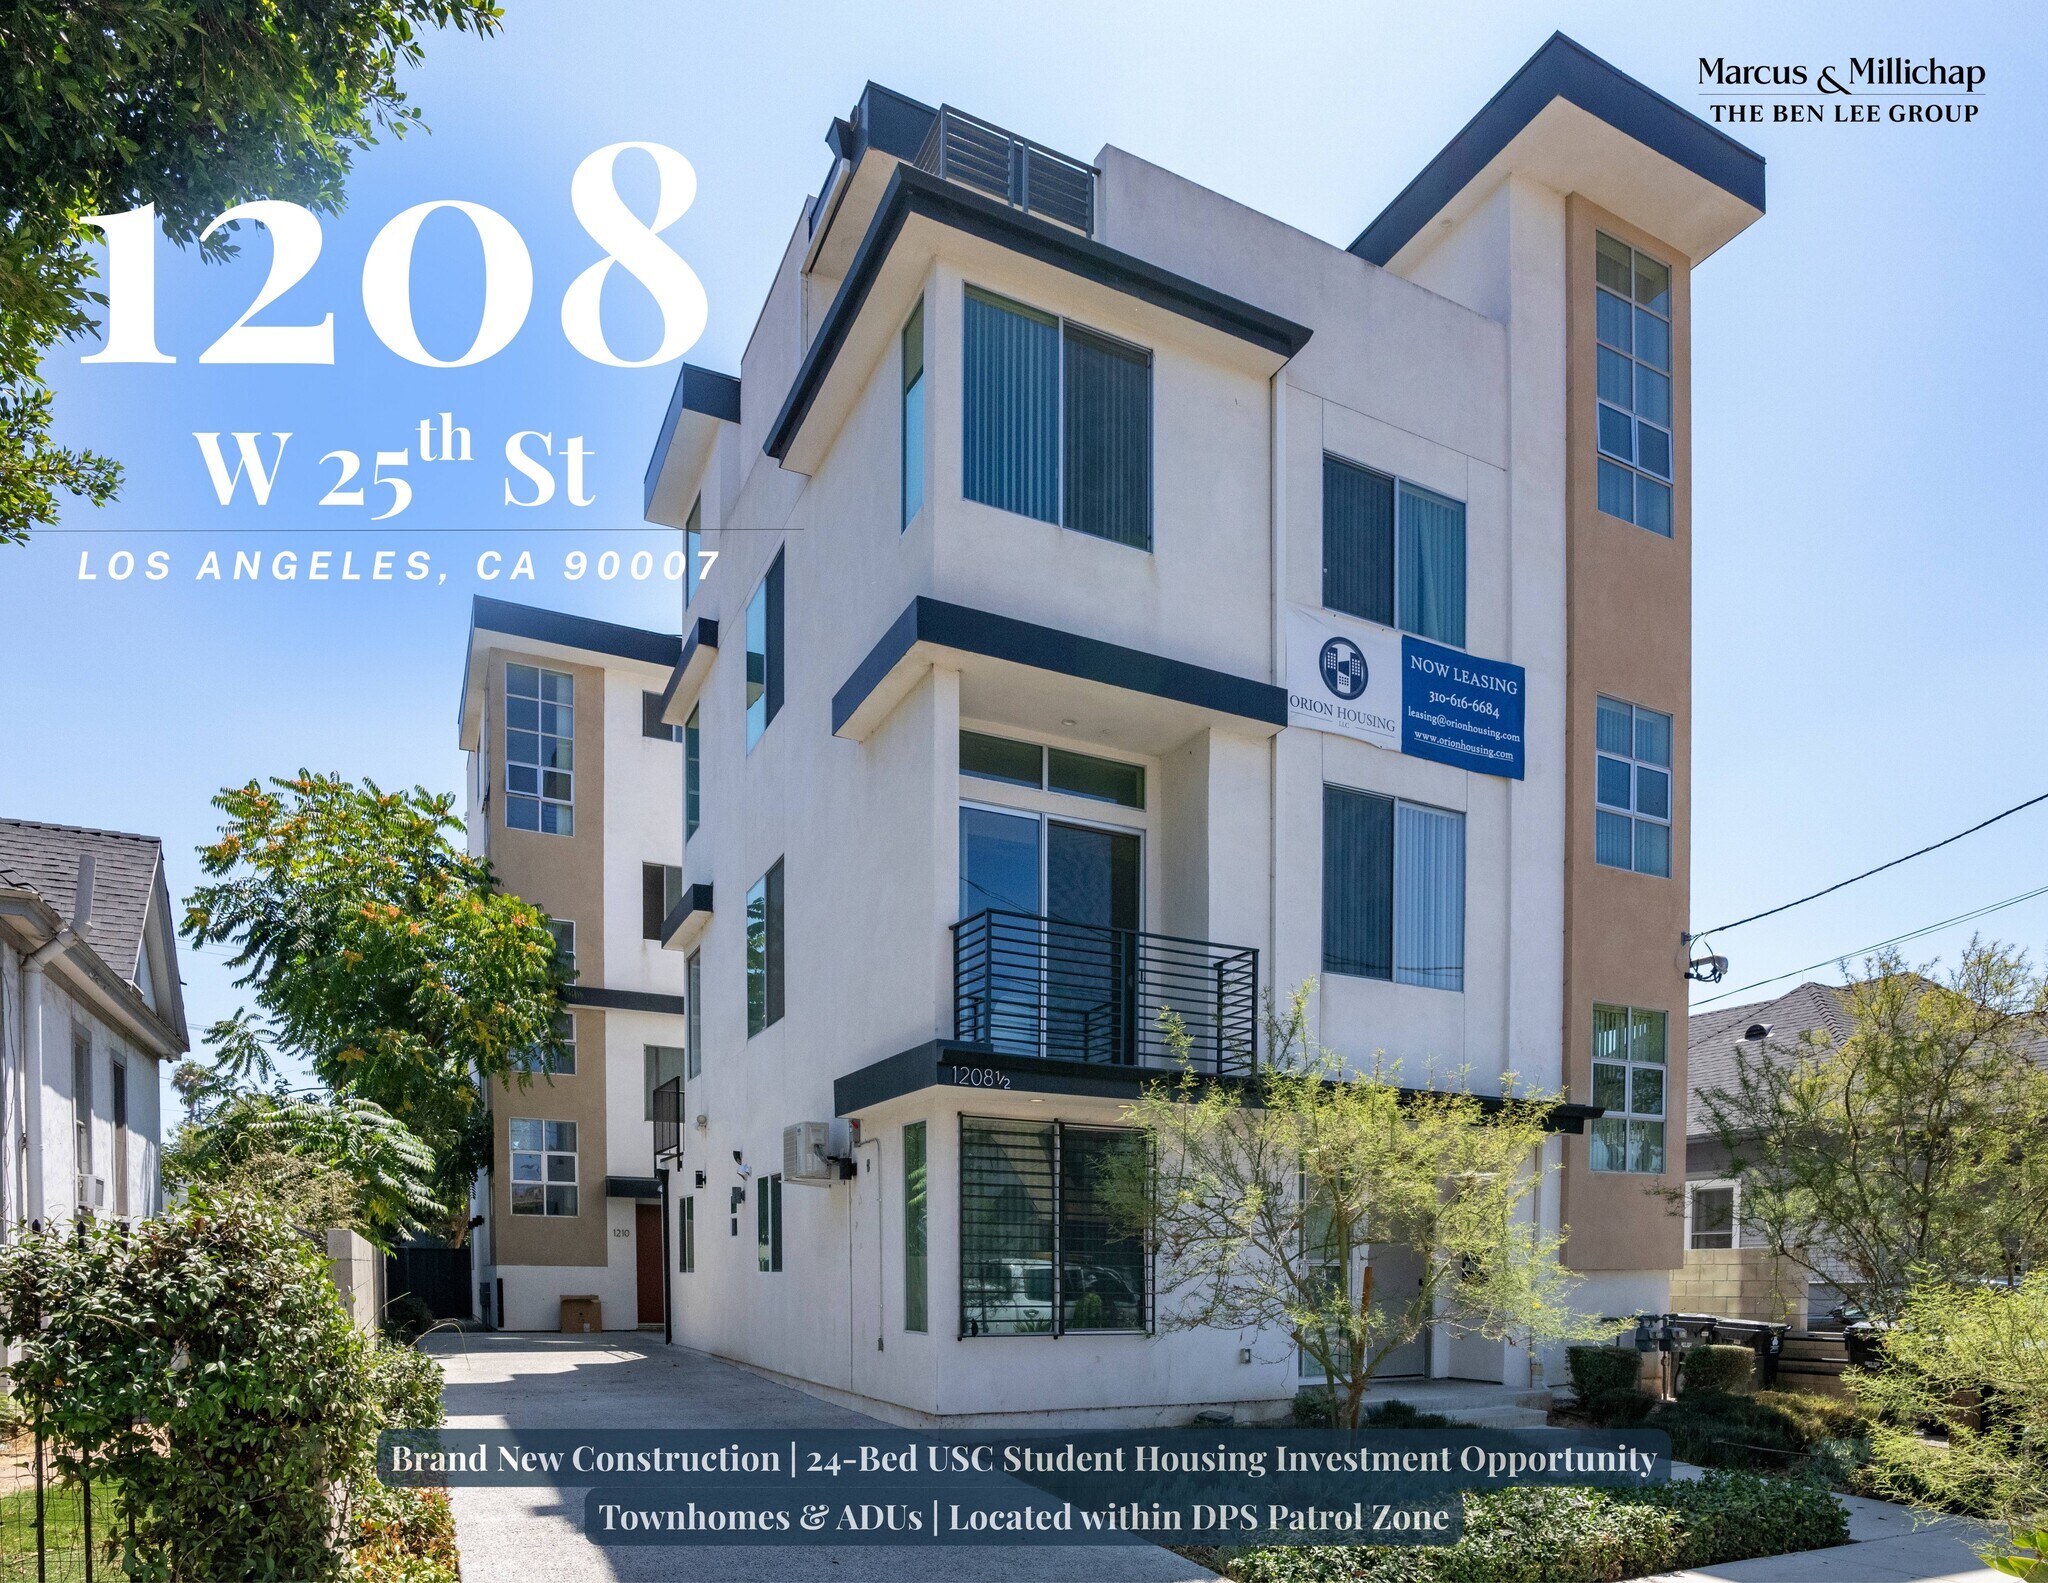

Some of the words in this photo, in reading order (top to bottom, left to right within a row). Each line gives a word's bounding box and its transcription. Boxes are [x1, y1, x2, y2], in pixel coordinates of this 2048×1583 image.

[1411, 655, 1450, 678] NOW
[1453, 667, 1518, 695] LEASING
[1289, 694, 1333, 716] ORION
[1337, 706, 1395, 732] HOUSING
[1429, 691, 1500, 719] 310-616-6684
[1338, 720, 1350, 729] LLC
[1408, 705, 1520, 742] leasing@orionhousing.com
[1414, 731, 1514, 761] www.orionhousing.com
[613, 1228, 631, 1238] 1210
